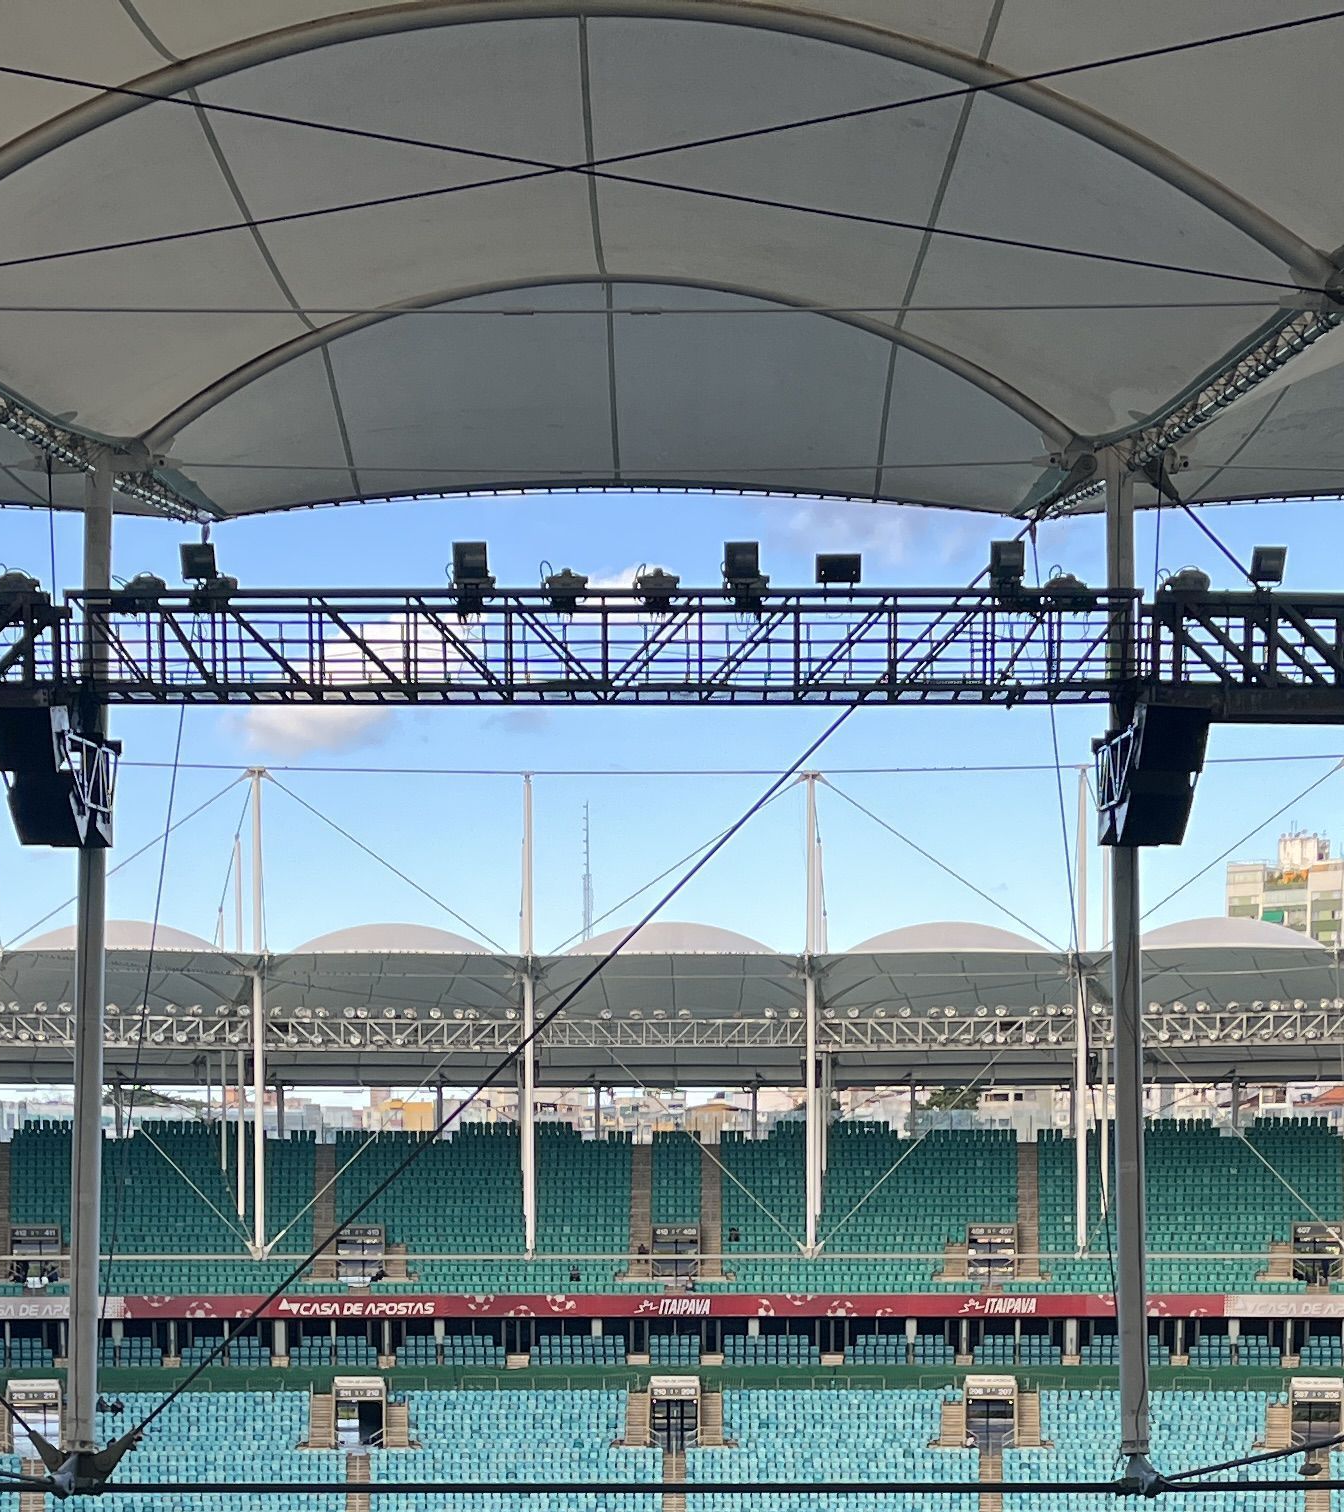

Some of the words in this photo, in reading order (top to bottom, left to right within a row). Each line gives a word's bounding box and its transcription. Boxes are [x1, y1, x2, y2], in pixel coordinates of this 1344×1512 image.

[43, 1229, 56, 1237] 411
[17, 1303, 40, 1317] DE
[298, 1301, 341, 1316] CASA
[342, 1301, 364, 1316] DE
[364, 1301, 436, 1316] APOSTAS
[657, 1297, 712, 1316] ITAIPAVA
[983, 1297, 1038, 1315] ITAIPAVA
[1255, 1301, 1298, 1316] CASA
[1301, 1302, 1323, 1316] DE
